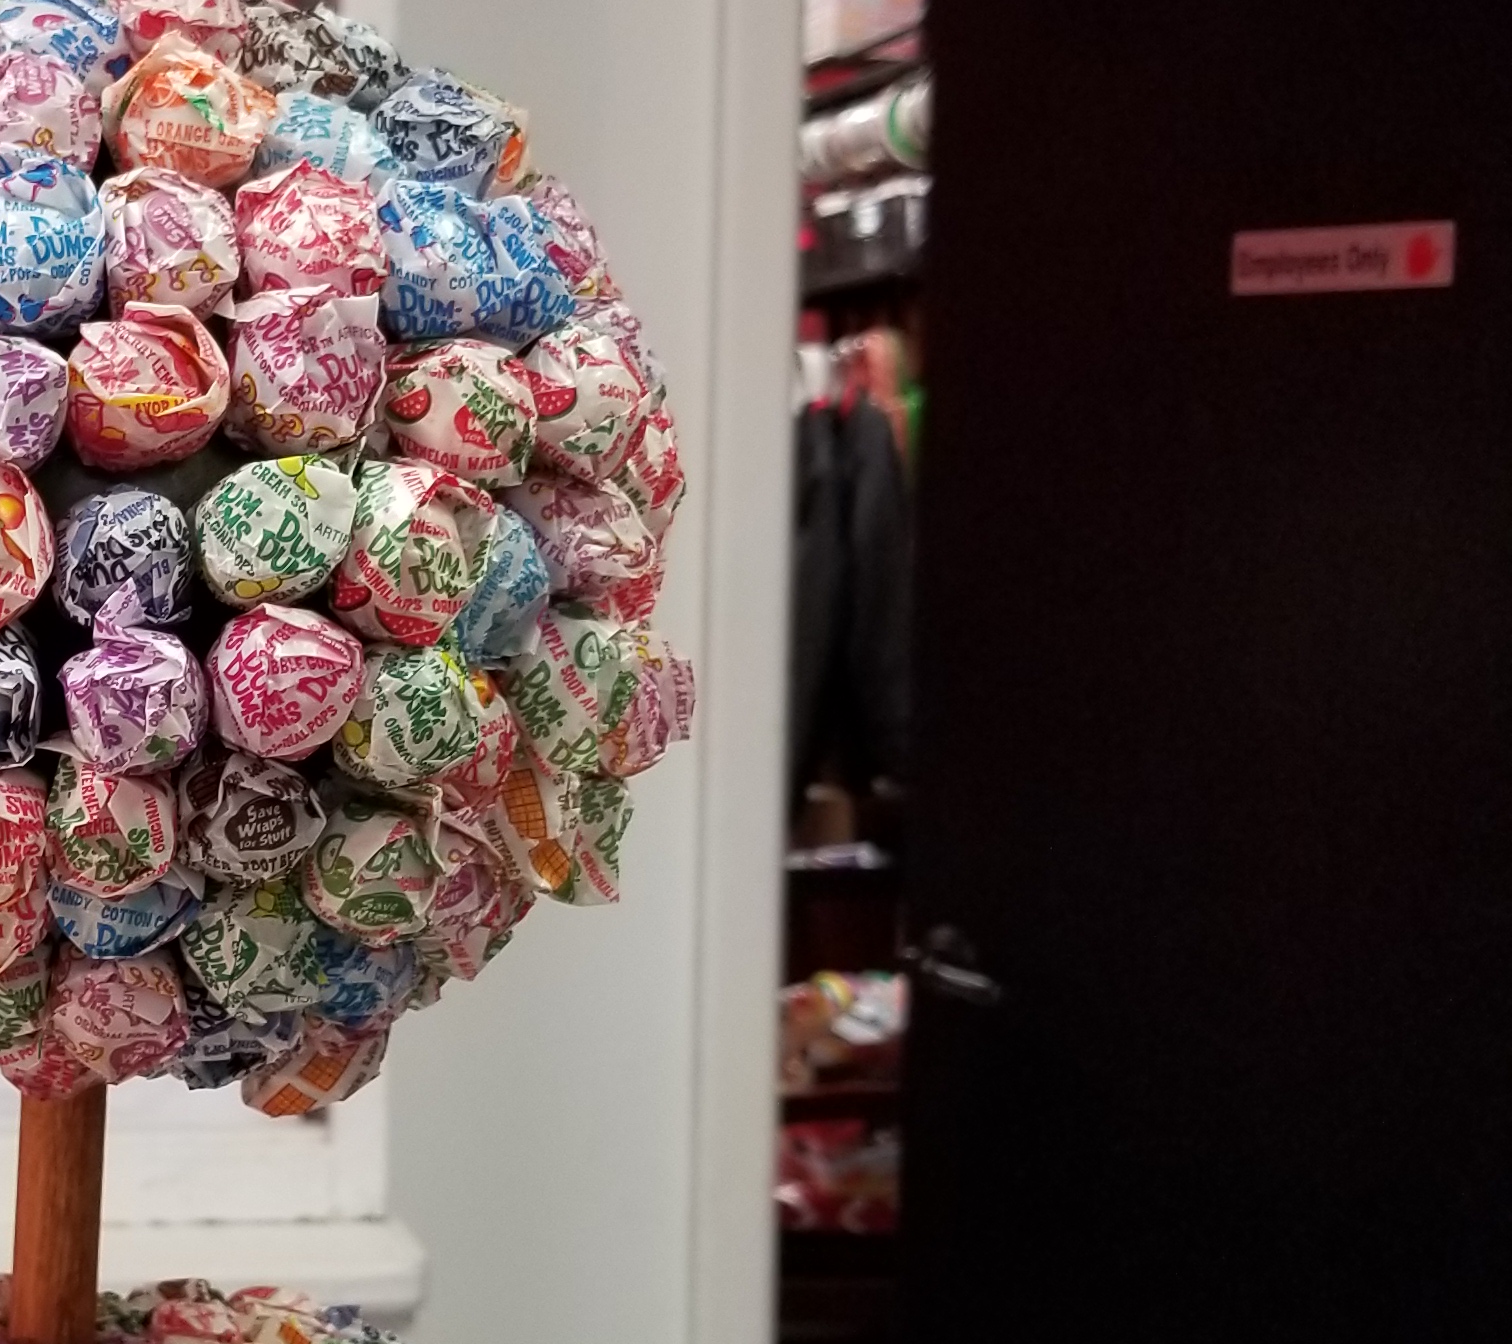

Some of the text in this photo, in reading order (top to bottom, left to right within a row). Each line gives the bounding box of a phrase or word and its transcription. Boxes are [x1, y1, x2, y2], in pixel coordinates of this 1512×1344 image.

[155, 122, 213, 146] ORANGE
[251, 463, 292, 500] CREAM
[305, 706, 338, 732] POPS
[247, 804, 282, 823] Save
[237, 816, 284, 838] Wraps
